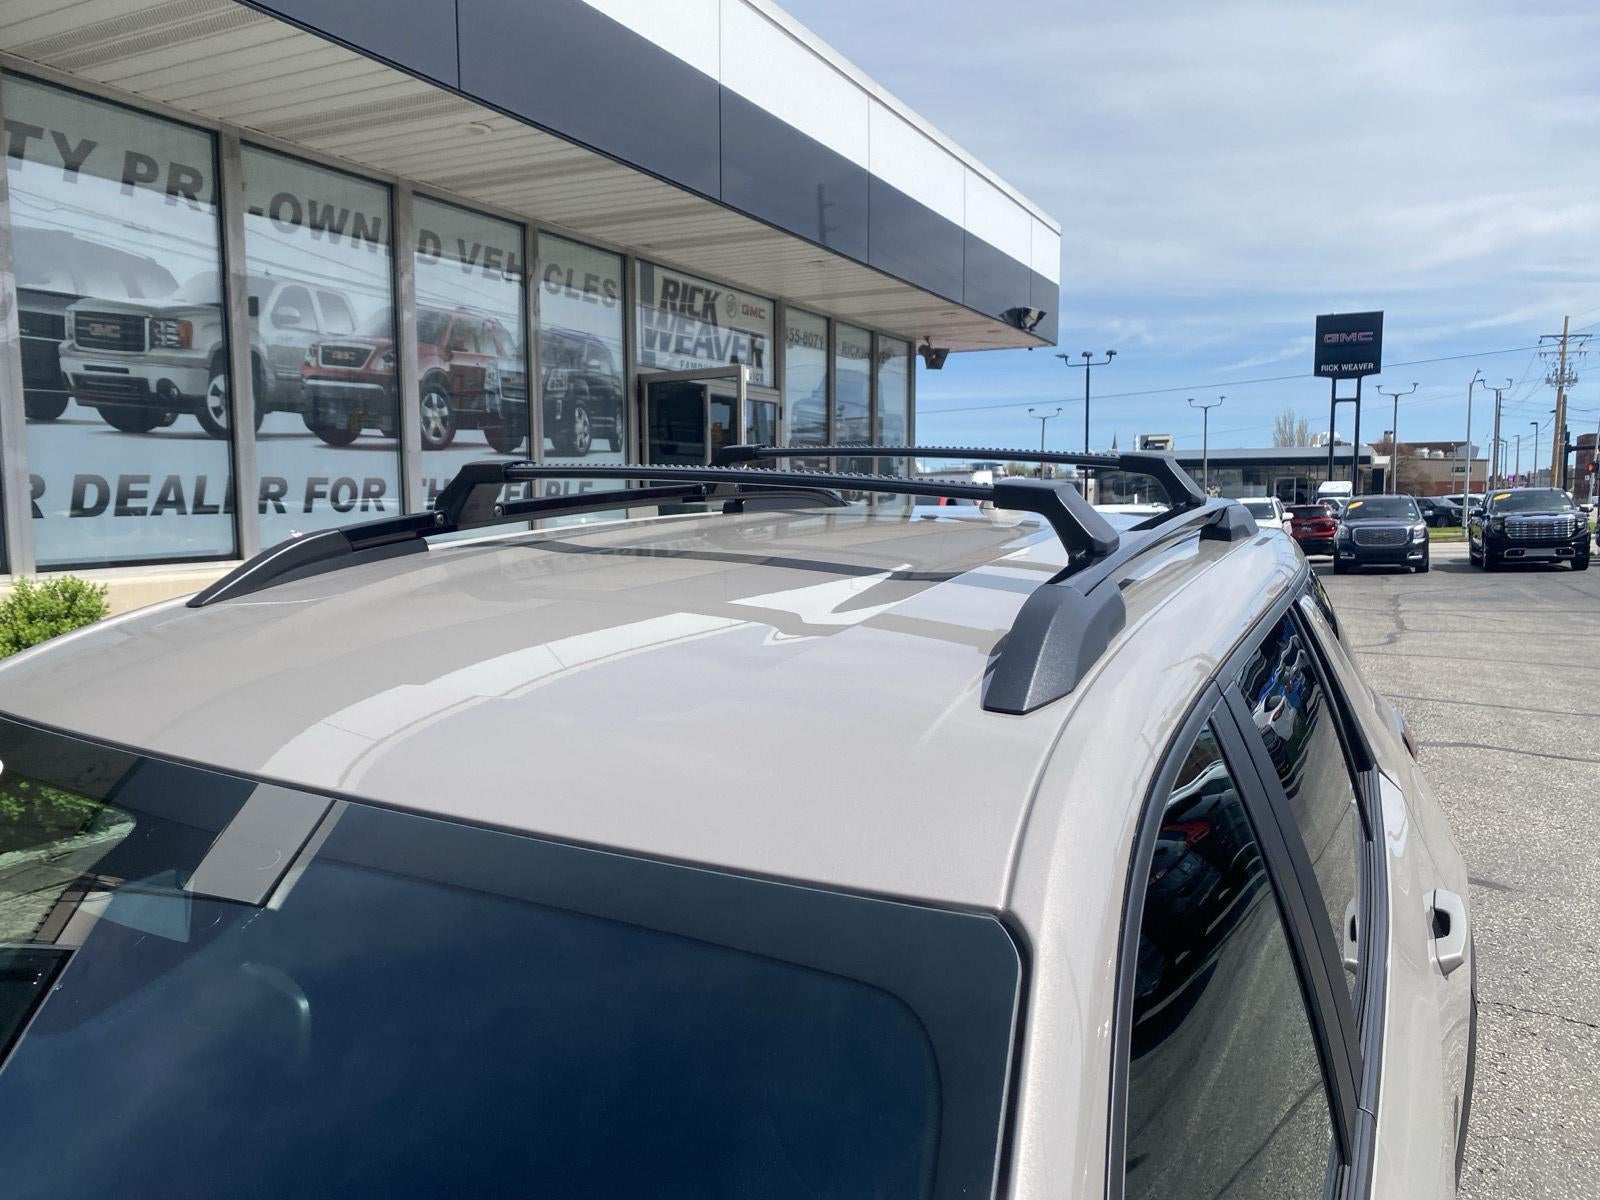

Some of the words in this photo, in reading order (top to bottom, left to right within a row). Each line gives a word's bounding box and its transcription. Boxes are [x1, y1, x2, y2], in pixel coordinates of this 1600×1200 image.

[659, 276, 722, 327] RICK
[741, 304, 766, 320] GMC
[1324, 332, 1373, 343] GMC
[1321, 364, 1339, 372] RICK
[1341, 362, 1374, 372] WEAVER
[303, 477, 387, 514] FOR
